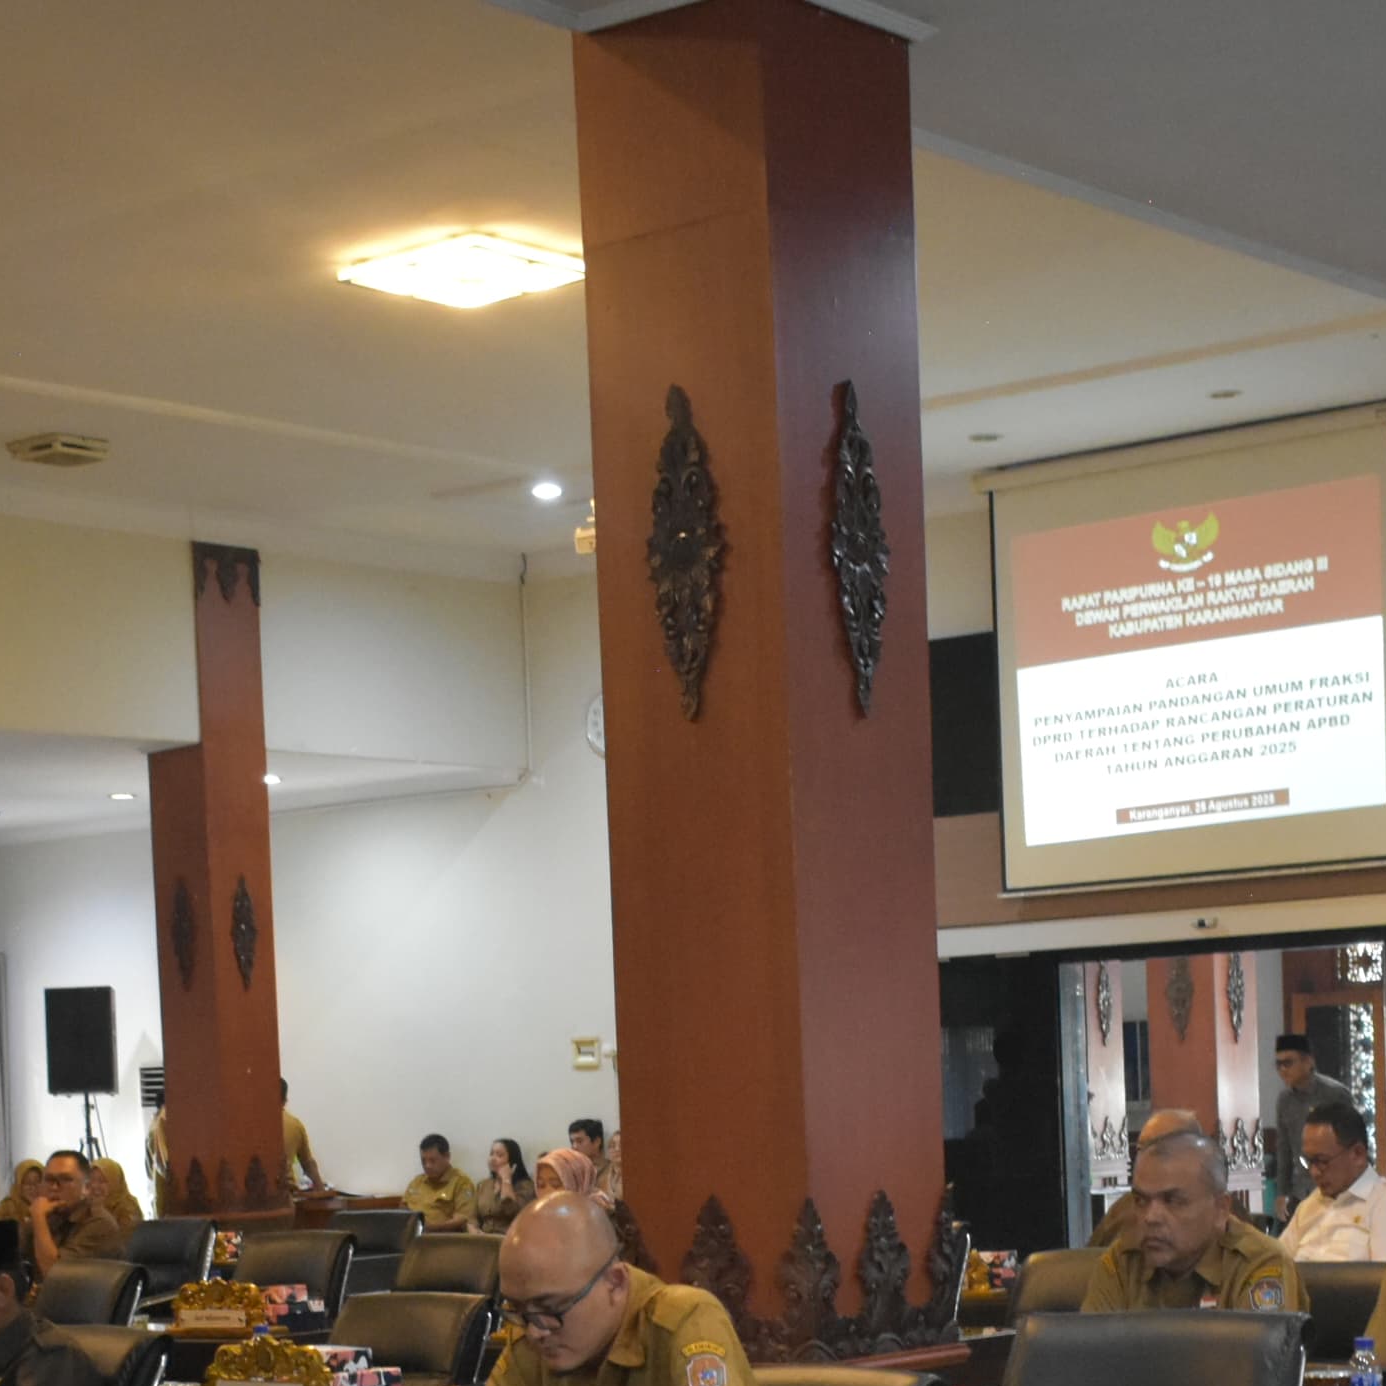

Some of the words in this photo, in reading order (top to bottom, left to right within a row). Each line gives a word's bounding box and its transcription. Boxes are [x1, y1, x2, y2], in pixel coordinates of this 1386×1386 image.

[1207, 583, 1257, 605] RAKYAT
[1259, 575, 1315, 598] DAERAH
[1034, 702, 1143, 728] PENYAMPAIAN
[1149, 688, 1247, 712] PANDANGAN
[1253, 680, 1303, 698] UMUM
[1310, 671, 1370, 690] FRAKSI
[1166, 671, 1218, 689] ACARA
[1032, 731, 1073, 747] DPRD
[1080, 719, 1160, 741] TERHADAP
[1166, 705, 1266, 729] RANCANGAN
[1273, 691, 1373, 714] PERATURAN
[1055, 745, 1116, 764] DAERAH
[1123, 734, 1195, 753] TENTANG
[1201, 720, 1300, 744] PERUBAHAN
[1306, 714, 1350, 731] APBD
[1107, 759, 1158, 776] TAHUN
[1165, 746, 1253, 769] ANGGARAN
